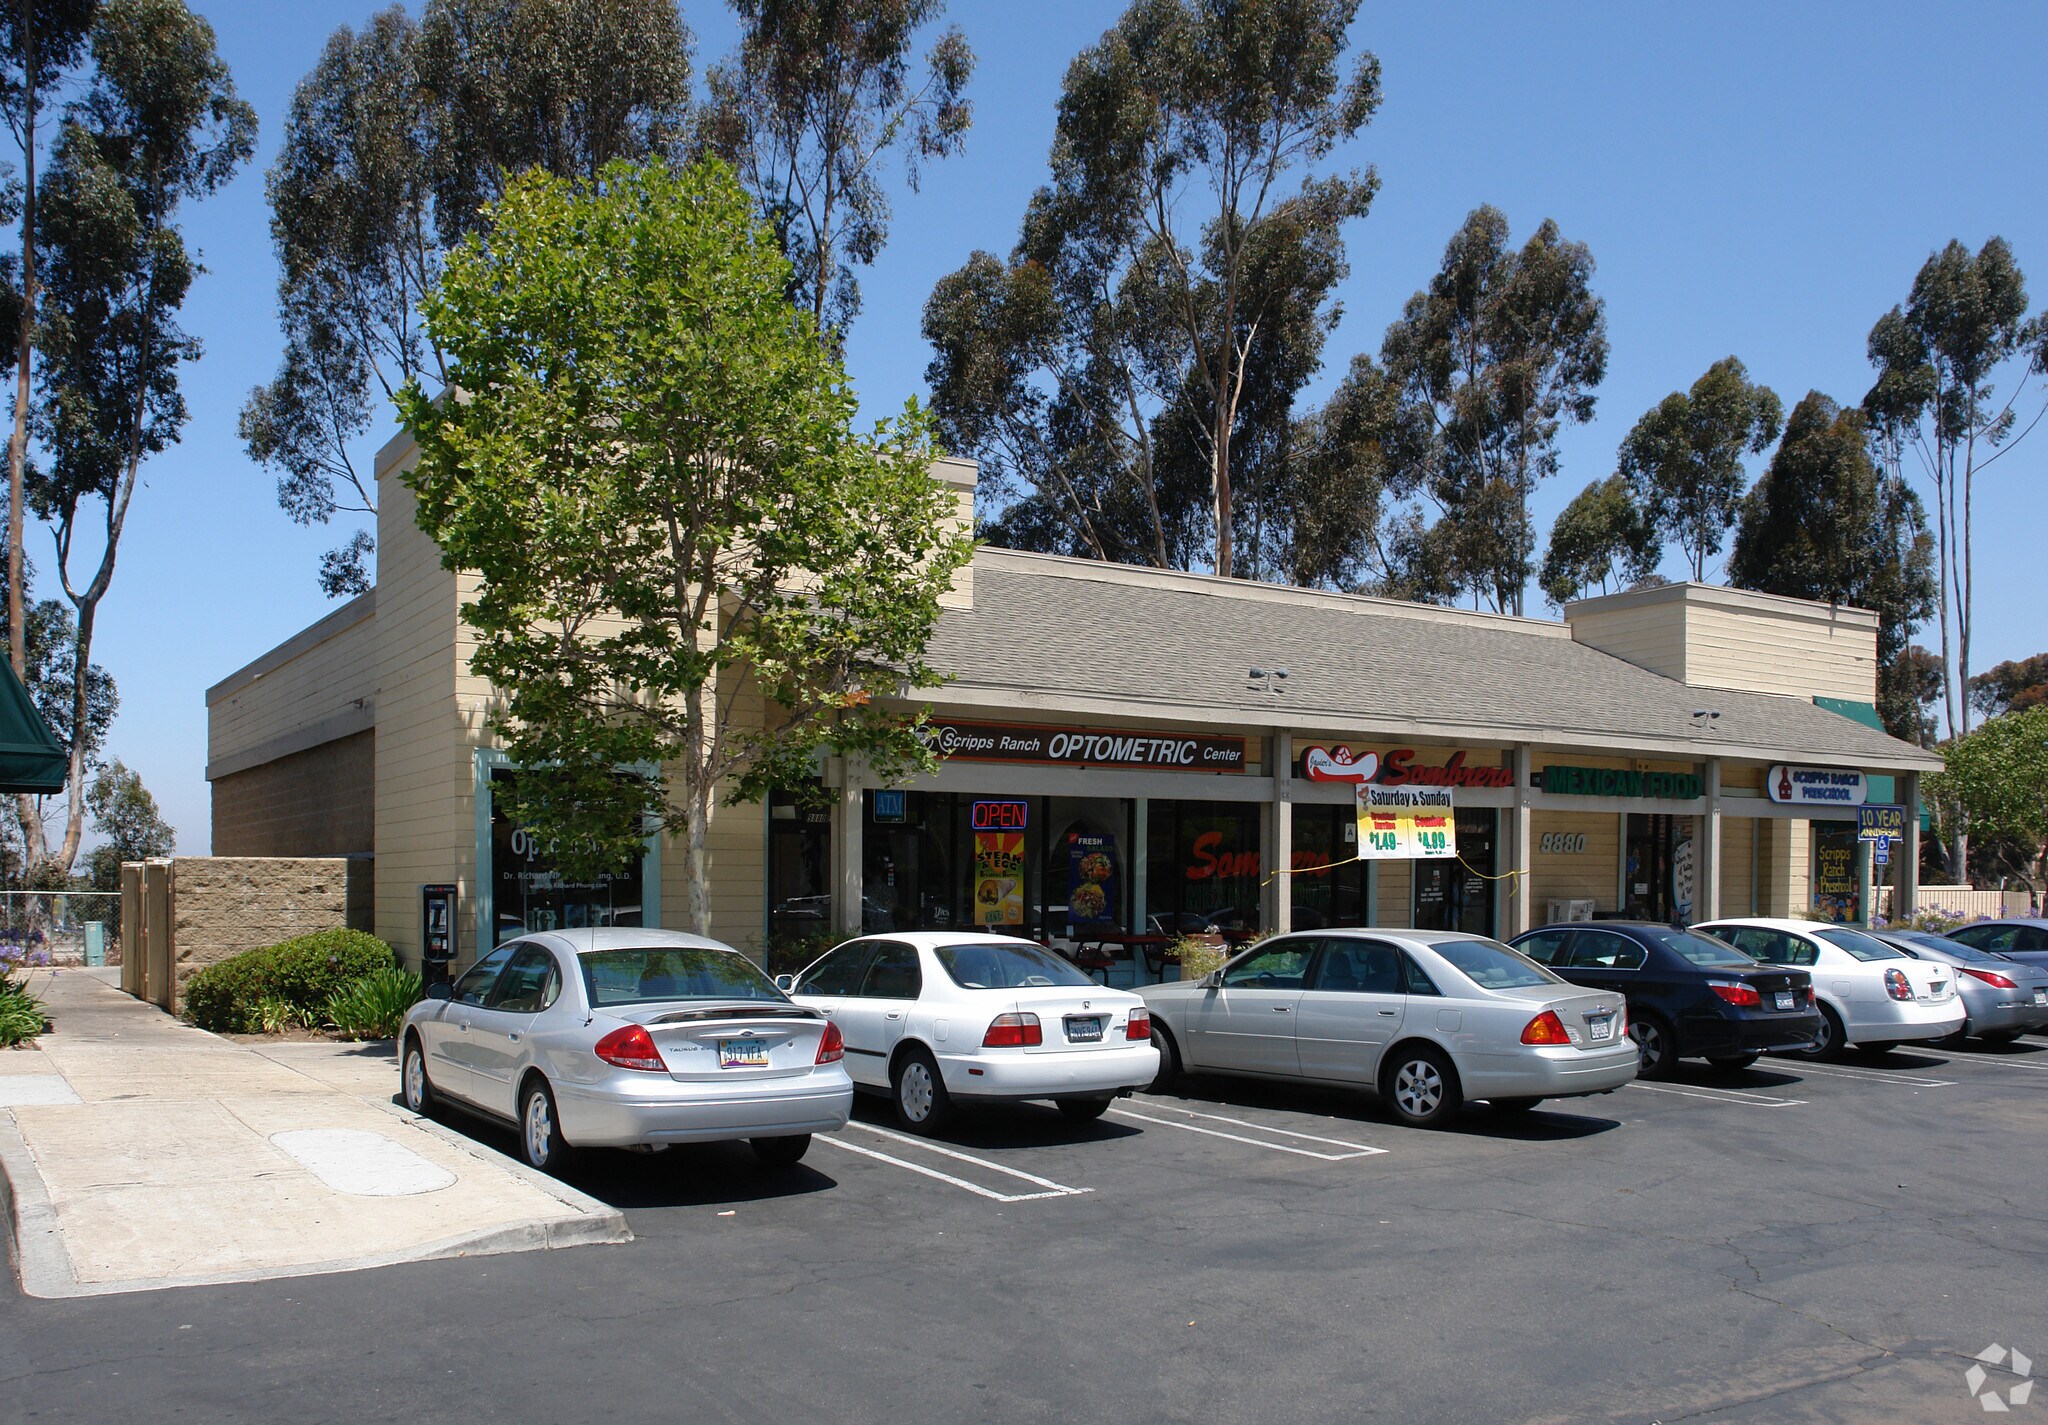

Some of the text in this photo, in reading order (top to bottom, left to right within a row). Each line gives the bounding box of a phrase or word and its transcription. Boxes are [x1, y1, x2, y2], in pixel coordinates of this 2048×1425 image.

[943, 731, 1242, 764] Scripps Ranch OPTOMETRIC Center
[1382, 749, 1516, 788] Sombrero
[1546, 766, 1701, 800] MEXICAN FOOD
[1793, 771, 1860, 787] SCRIPPS RANCH
[1370, 789, 1450, 808] Saturday & Sunday
[1802, 786, 1852, 801] PRESCHOOL
[877, 794, 904, 814] ATM
[974, 804, 1025, 827] OPEN
[1861, 810, 1901, 827] 10 YEAR
[1078, 837, 1103, 846] FRESH
[1369, 831, 1397, 851] $1.49
[1417, 831, 1446, 850] $4.99
[1539, 831, 1586, 854] 9880
[977, 851, 1022, 865] STEAK
[1184, 831, 1330, 880] Somero
[1818, 845, 1851, 865] Scripps
[994, 859, 1017, 871] EGG
[1822, 862, 1846, 877] Ranch
[503, 872, 516, 880] Dr.
[517, 872, 548, 880] Richard
[1820, 876, 1852, 894] Preschool
